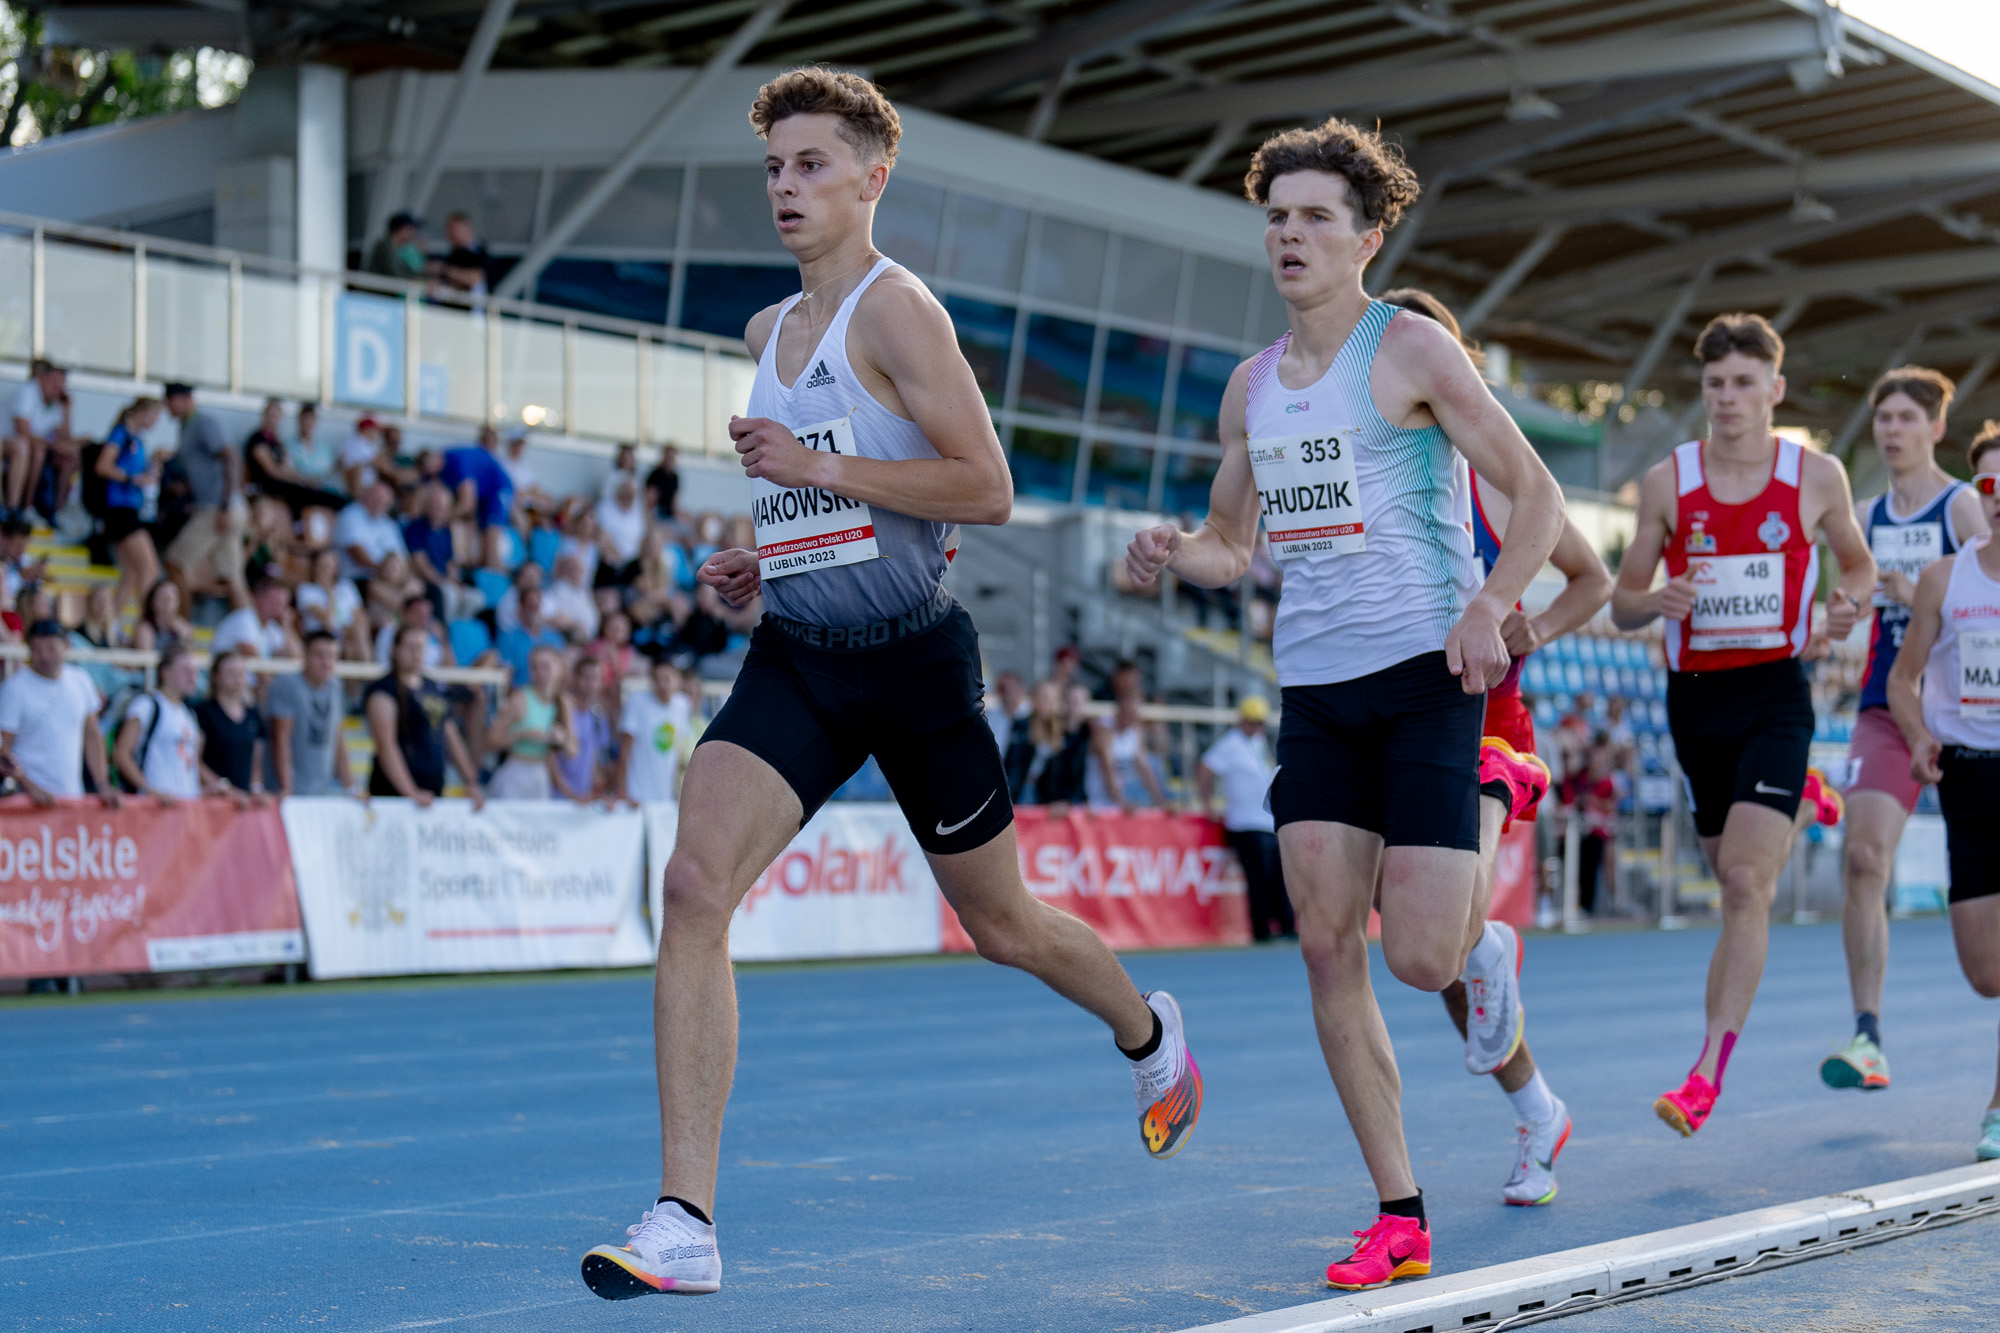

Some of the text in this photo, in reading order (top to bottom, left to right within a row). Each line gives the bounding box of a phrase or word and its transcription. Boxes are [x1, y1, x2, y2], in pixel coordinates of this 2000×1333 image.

[346, 325, 392, 397] D
[806, 374, 836, 389] adidas
[1300, 437, 1341, 463] 353
[772, 539, 819, 554] Mistrzostwa
[818, 532, 844, 545] Polski
[844, 529, 863, 540] U20
[1284, 529, 1321, 541] Mistrzostwa
[1320, 527, 1339, 538] Polski
[1339, 525, 1355, 535] U20
[1282, 540, 1333, 554] LUBLIN 2023
[768, 549, 836, 571] LUBLIN 2023
[1743, 561, 1770, 579] 48
[826, 621, 890, 649] PRO
